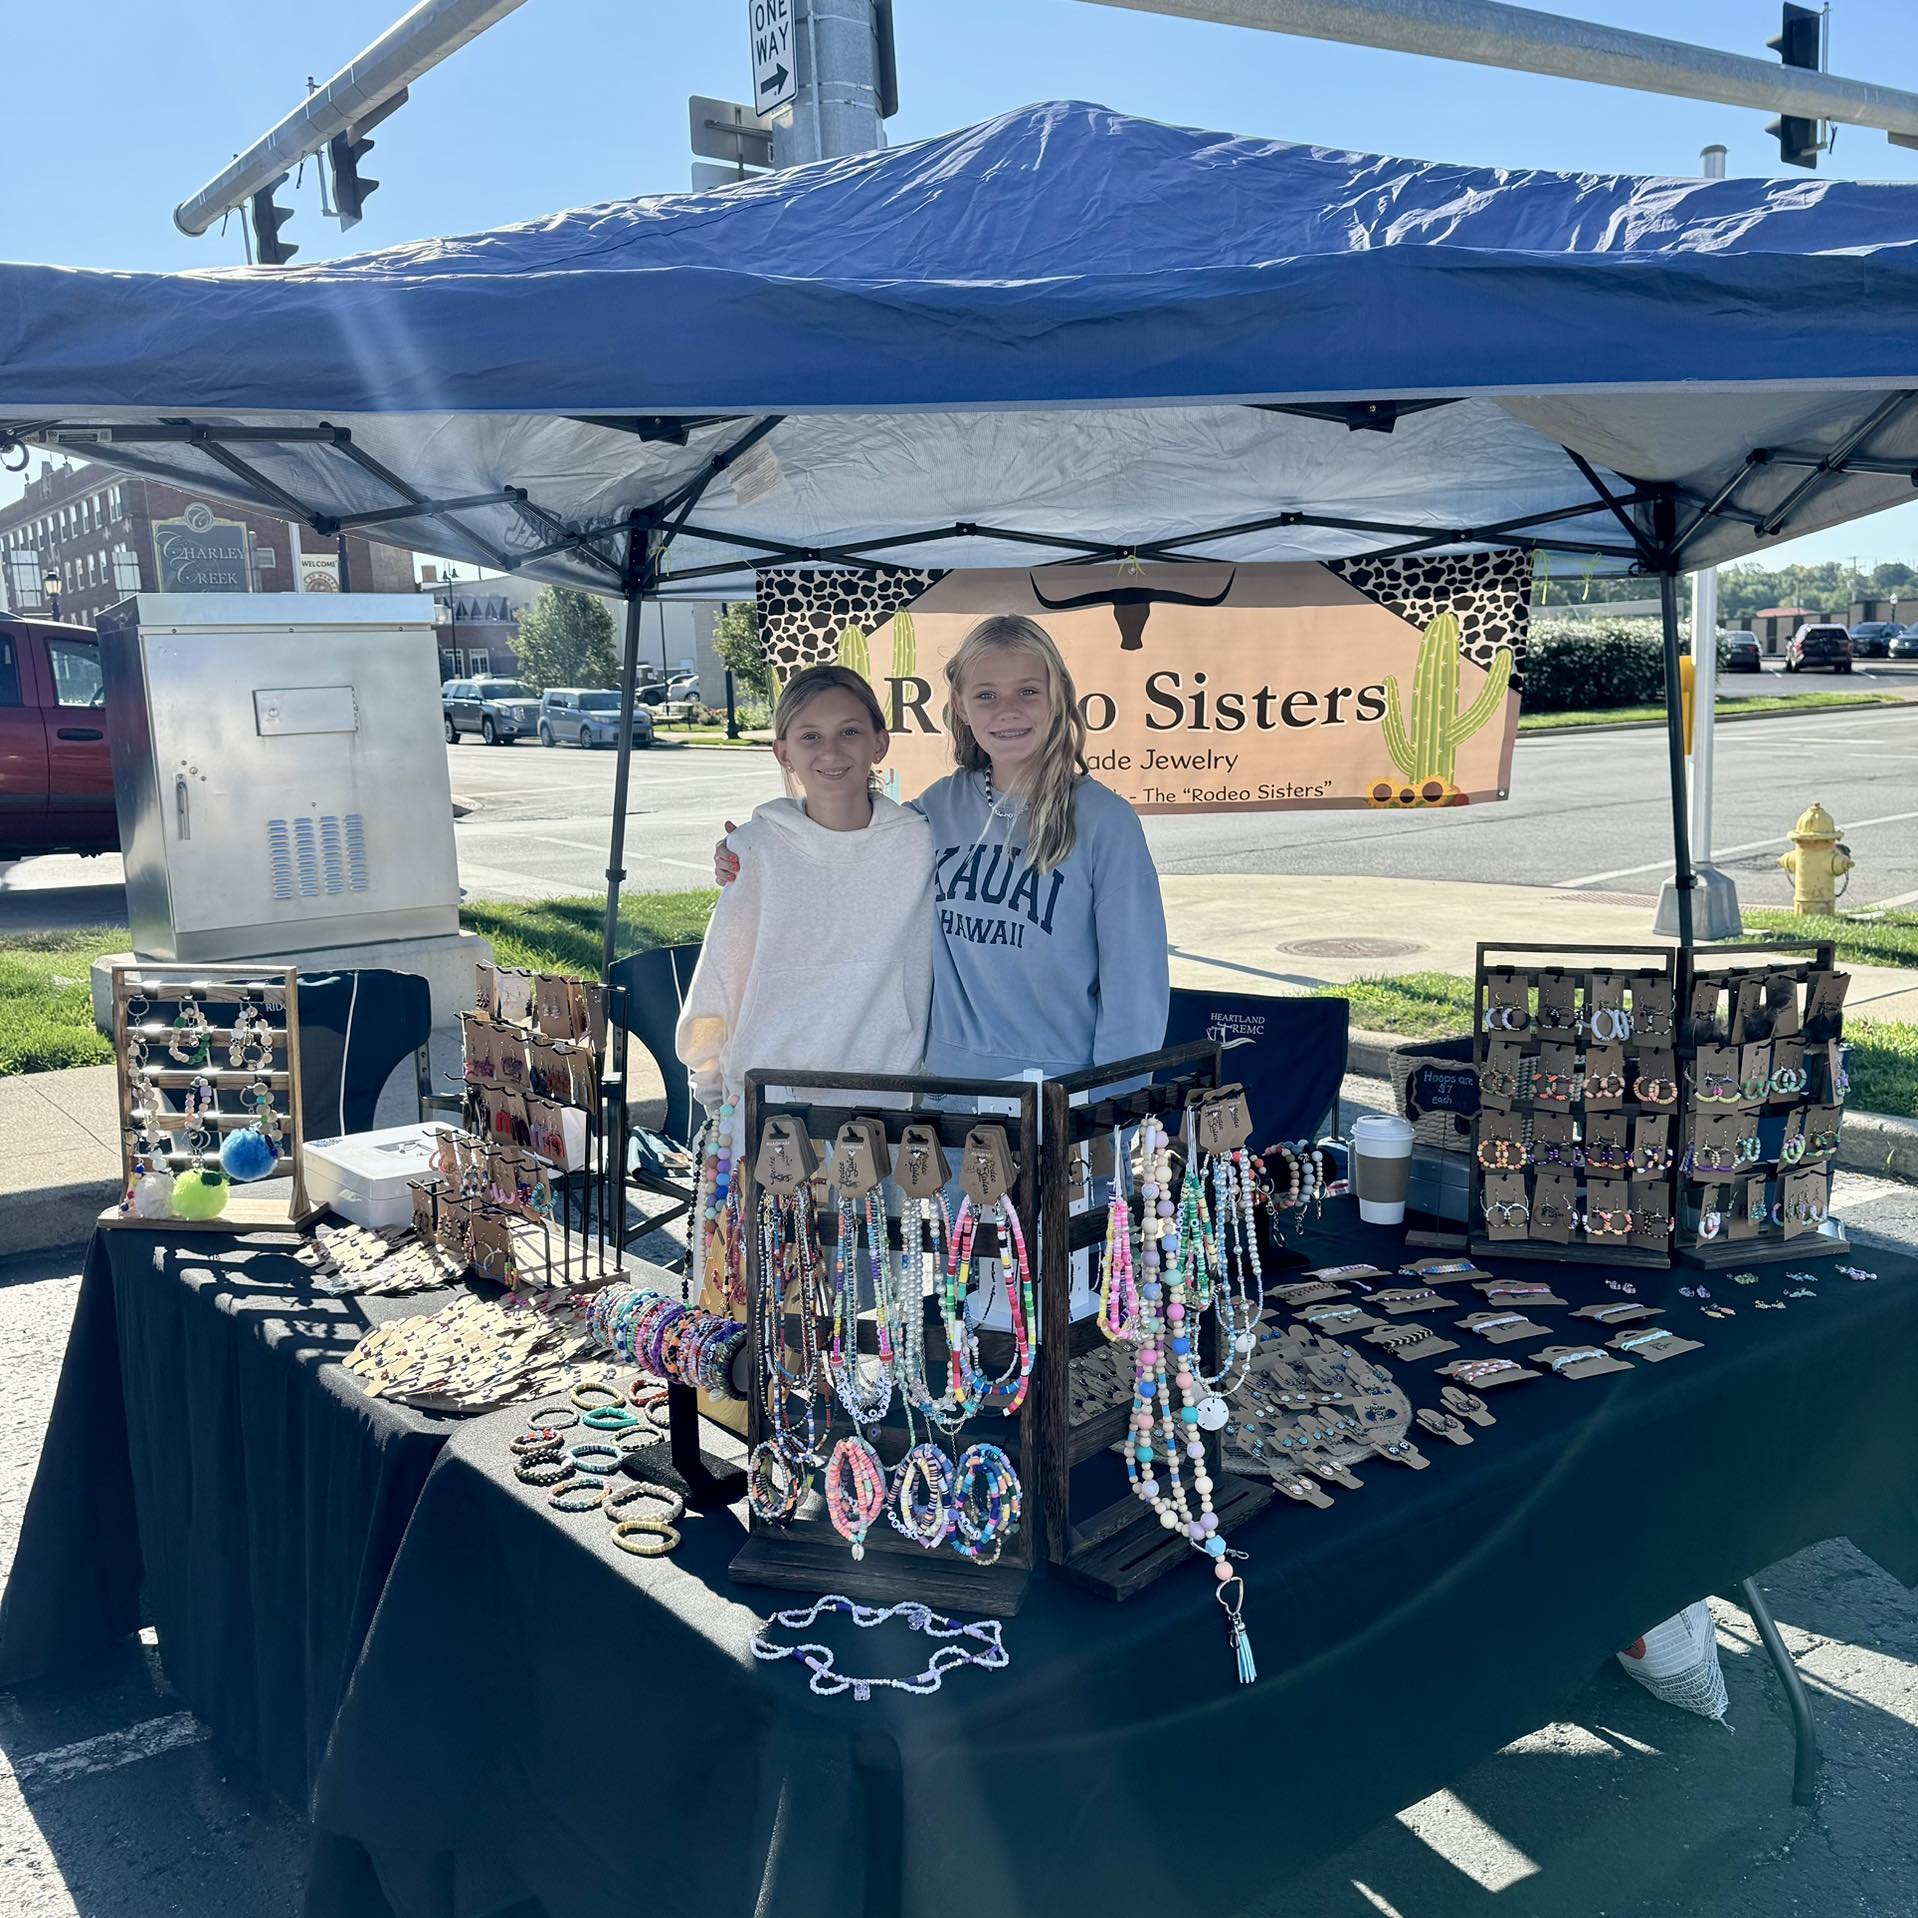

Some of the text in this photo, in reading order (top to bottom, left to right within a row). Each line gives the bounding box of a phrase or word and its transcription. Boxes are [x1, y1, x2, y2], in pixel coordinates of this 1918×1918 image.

[755, 0, 788, 32] ONE
[756, 21, 789, 66] WAY
[1145, 671, 1387, 731] Sisters
[1140, 749, 1239, 773] Jewelry
[1143, 787, 1176, 802] The
[935, 844, 1065, 936] KAUAI
[941, 909, 1025, 948] HAWAII
[265, 1003, 287, 1012] RID
[1210, 1012, 1265, 1024] HEARTLAND
[1231, 1024, 1264, 1035] REMC
[1424, 1071, 1456, 1085] Hoops
[1431, 1095, 1453, 1105] each
